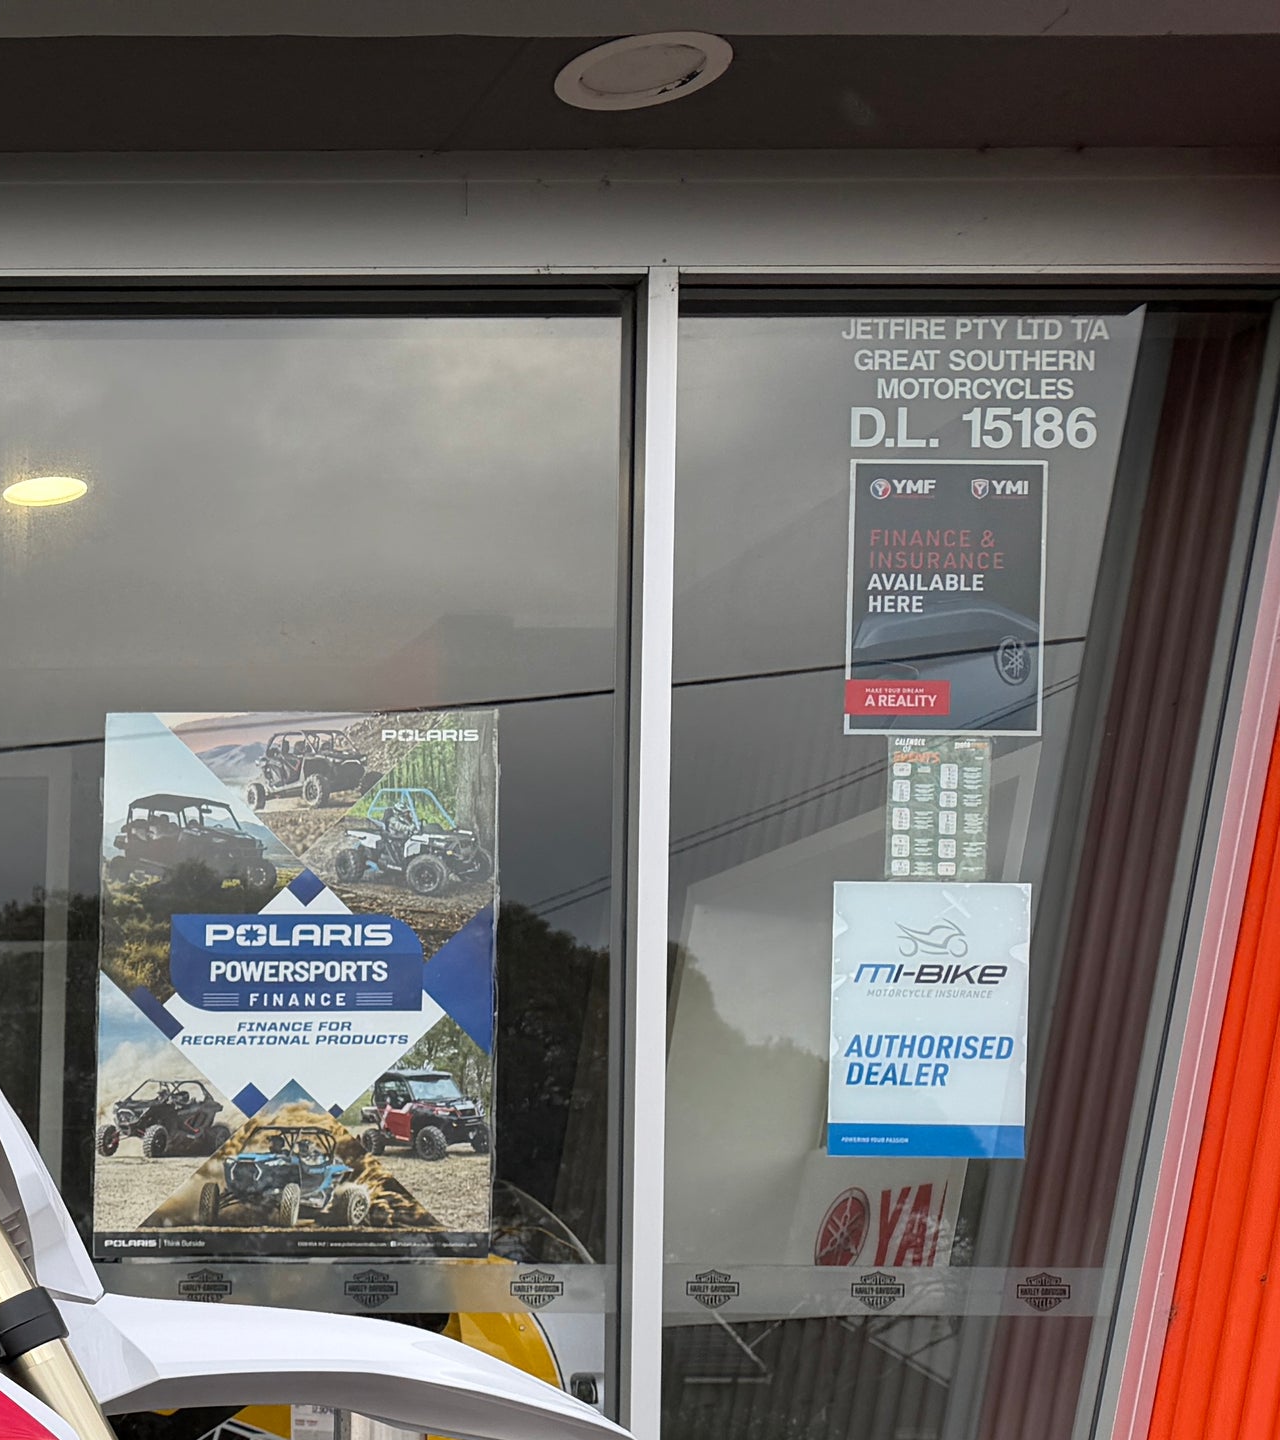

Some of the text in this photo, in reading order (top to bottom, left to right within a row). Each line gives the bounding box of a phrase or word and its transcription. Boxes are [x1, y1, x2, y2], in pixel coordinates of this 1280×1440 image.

[842, 318, 1110, 343] JETFIRE PTY LTD T/A
[854, 350, 1095, 371] GREAT SOUTHERN
[877, 377, 1074, 400] MOTORCYCLES
[850, 406, 1097, 449] D.L. 15186
[892, 479, 936, 494] YMF
[992, 480, 1029, 495] YMI
[870, 529, 995, 548] FINANCE &
[869, 551, 1005, 569] INSURANCE
[867, 573, 984, 591] AVAILABLE
[868, 595, 924, 613] HERE
[864, 694, 937, 707] A REALITY
[382, 729, 479, 742] POLARIS
[205, 924, 393, 947] POLARIS
[210, 960, 388, 983] POWERSPORTS
[249, 992, 347, 1007] FINANCE
[867, 988, 993, 999] MOTORCYCLE INSURANCE
[237, 1021, 352, 1032] FINANCE FOR
[181, 1034, 409, 1046] RECREATIONAL PRODUCTS
[844, 1034, 1014, 1060] AUTHORISED
[846, 1062, 950, 1086] DEALER
[104, 1239, 157, 1247] POLARIS
